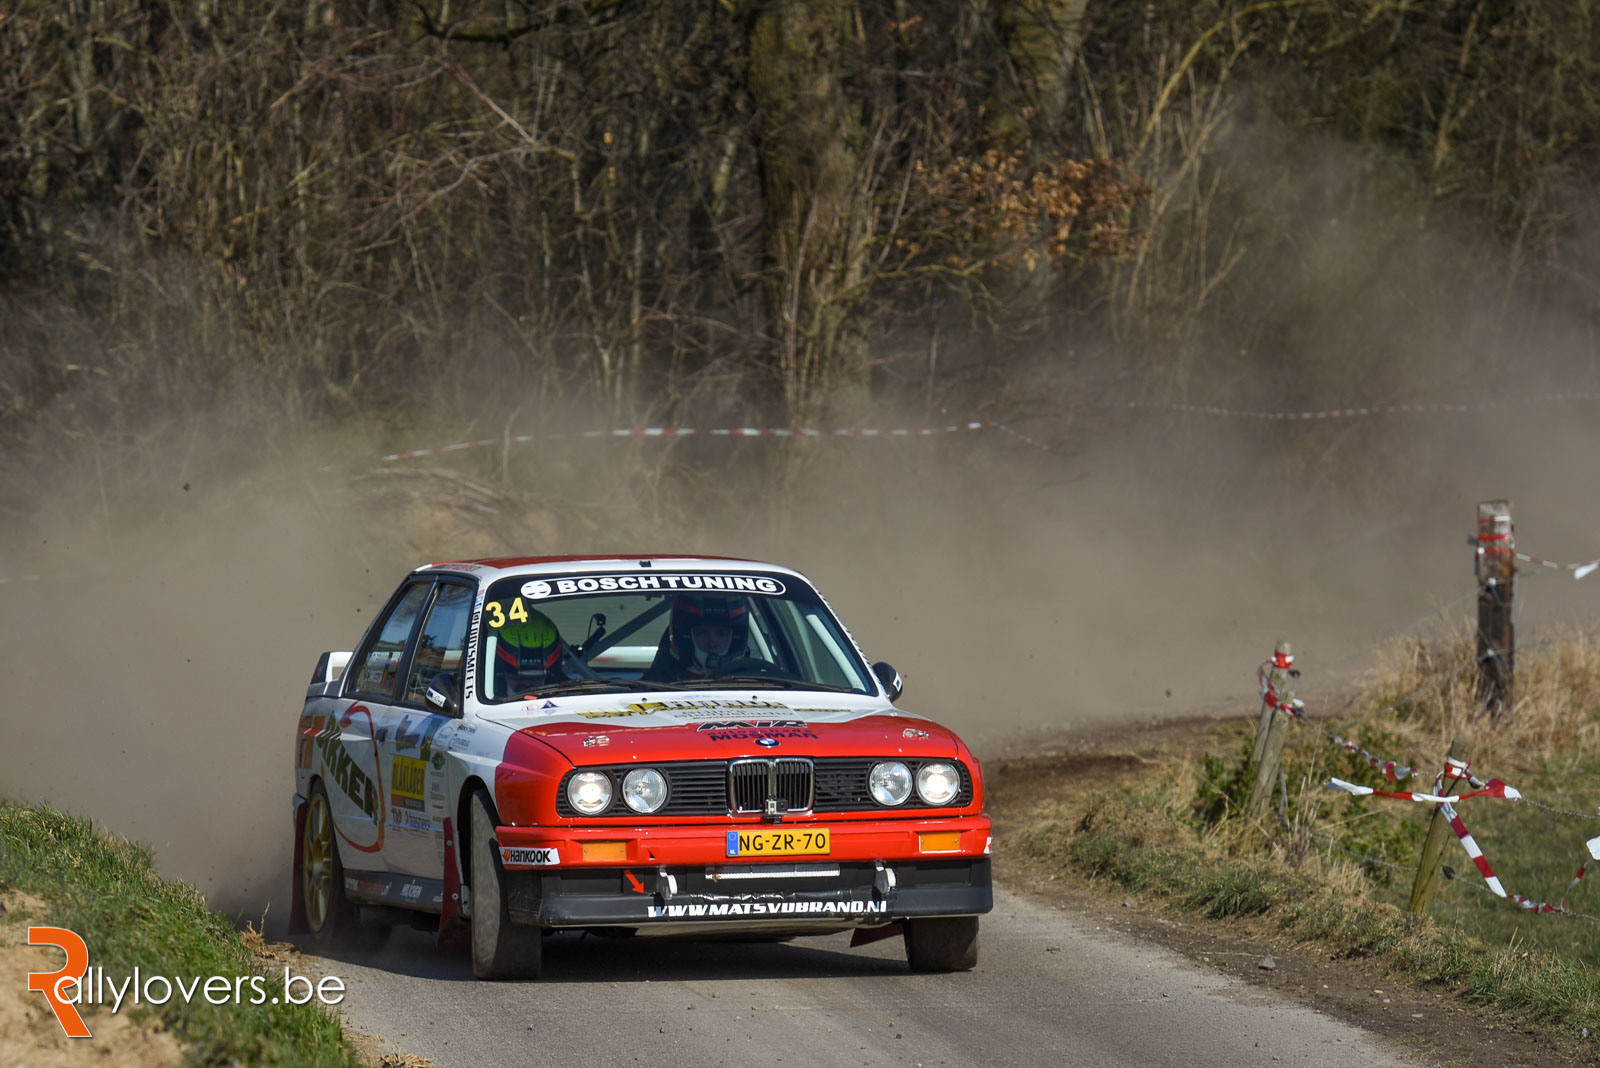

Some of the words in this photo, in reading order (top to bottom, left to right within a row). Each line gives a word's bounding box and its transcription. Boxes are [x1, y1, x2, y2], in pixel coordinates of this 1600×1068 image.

[485, 597, 529, 628] 34
[709, 731, 819, 742] MOSMAN
[738, 833, 826, 851] NG-ZR-70
